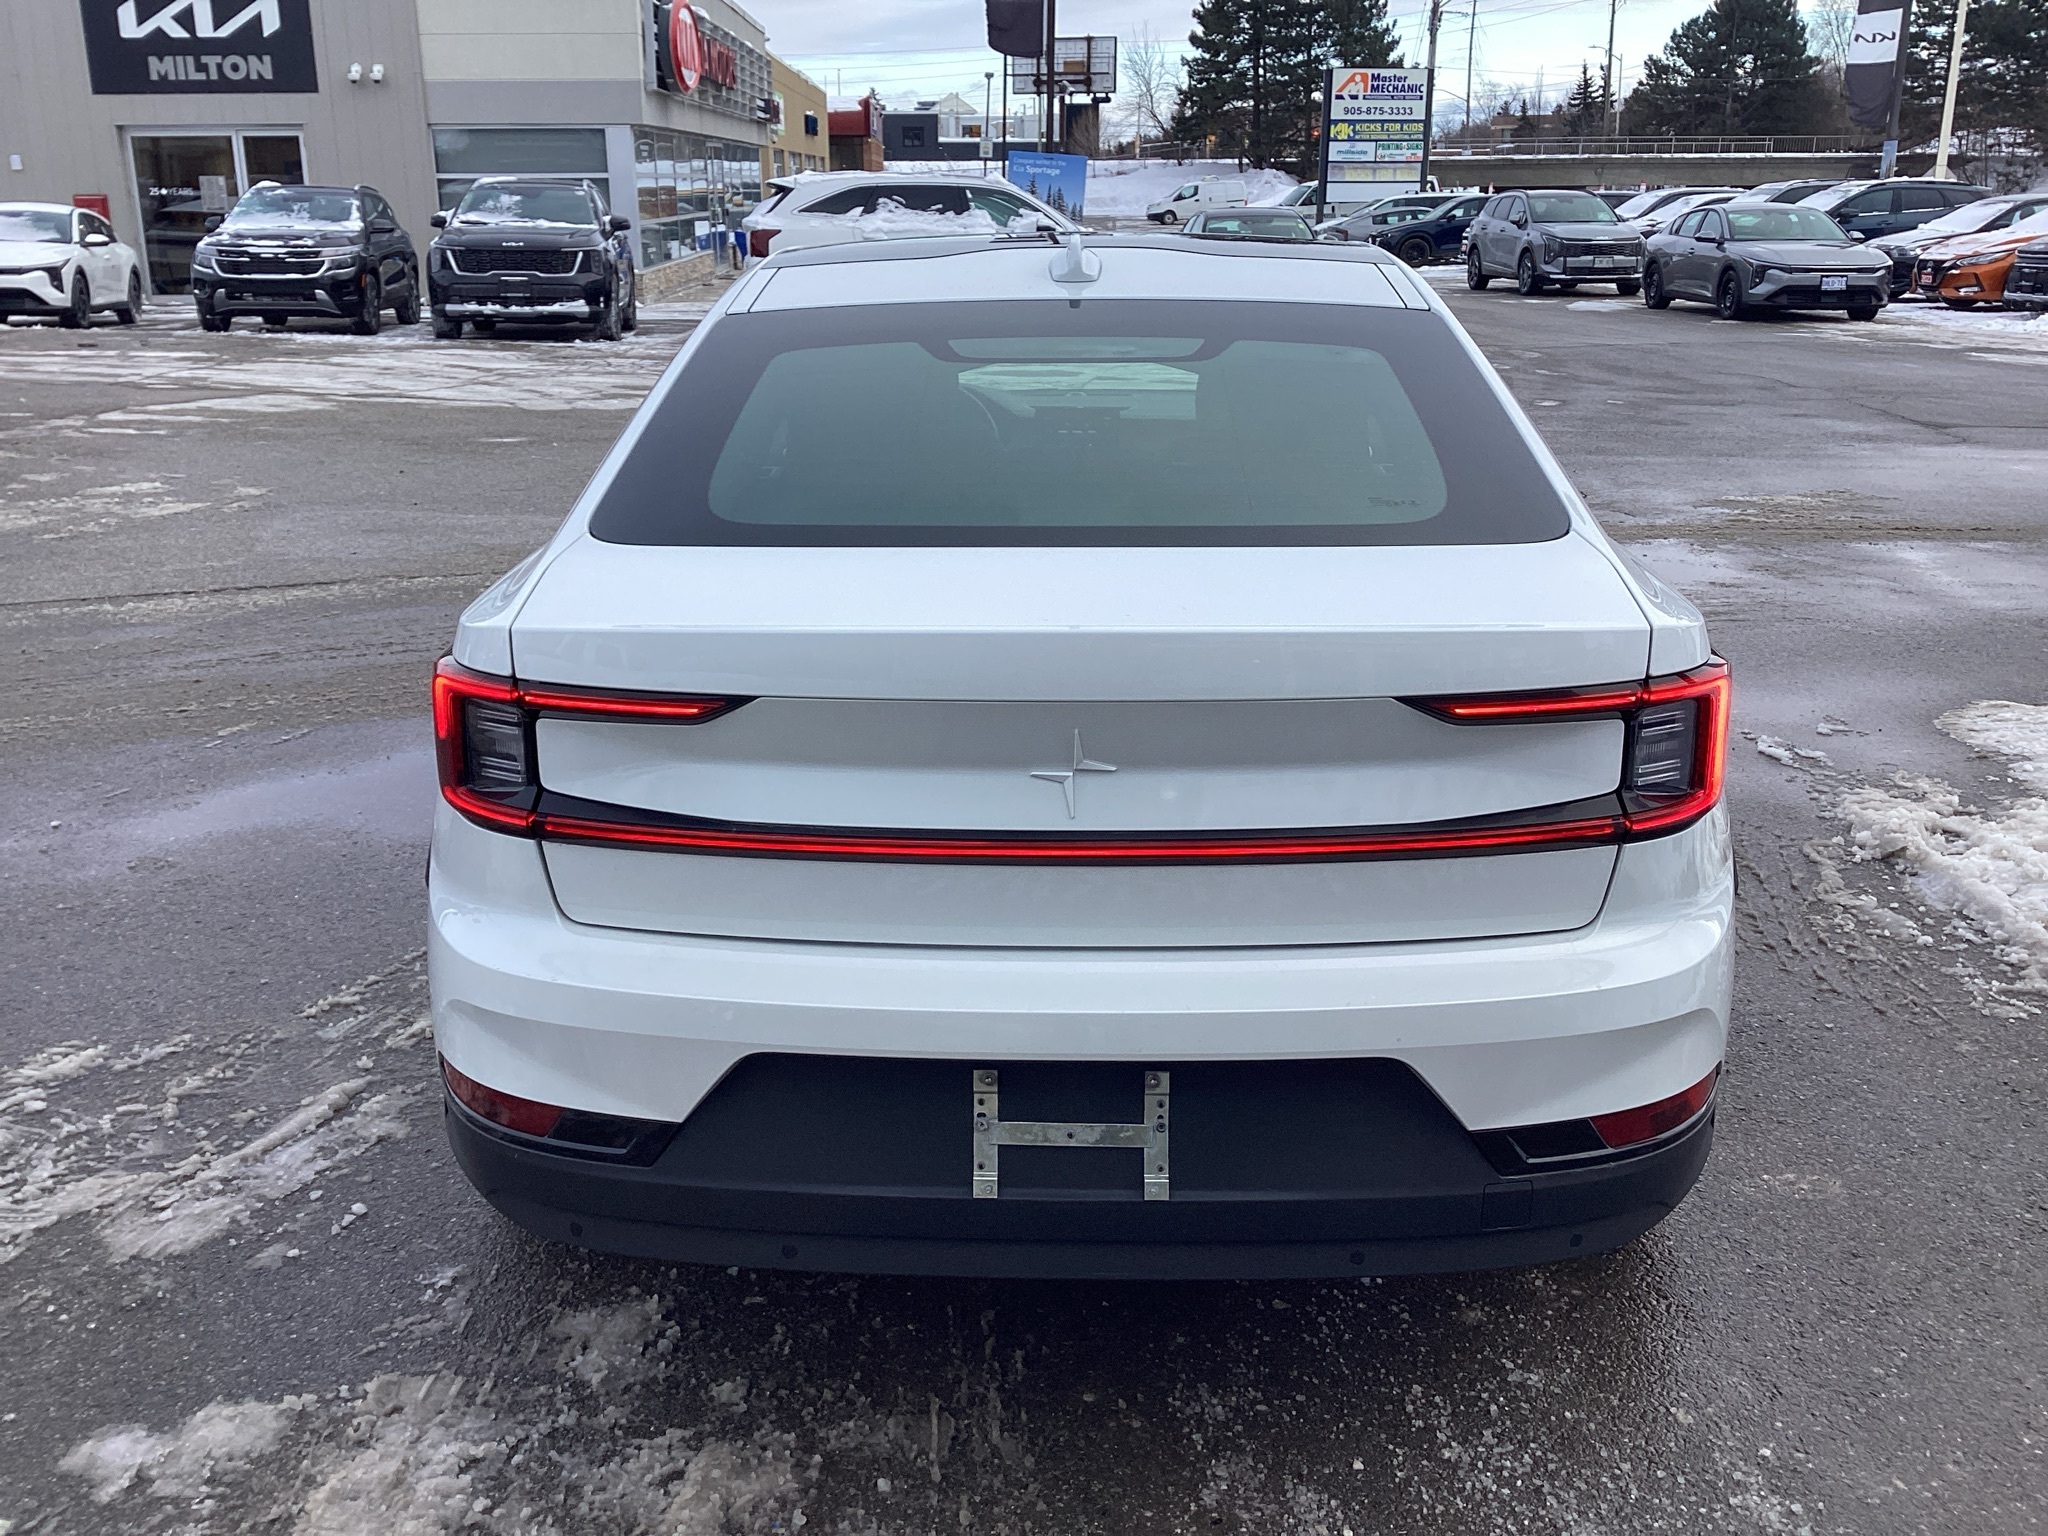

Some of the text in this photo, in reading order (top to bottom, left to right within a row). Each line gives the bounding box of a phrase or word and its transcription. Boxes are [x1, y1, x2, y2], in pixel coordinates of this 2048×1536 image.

[147, 55, 274, 81] MILTON
[1371, 73, 1408, 83] Master
[1370, 84, 1424, 94] MECHANIC
[1343, 106, 1413, 116] 905-875-3333
[1356, 123, 1424, 132] KICKS FOR KIDS
[1378, 143, 1403, 151] PRINTING
[1406, 143, 1423, 151] SIGNS
[1026, 165, 1060, 176] Sportage
[149, 188, 194, 196] 25 YEARS
